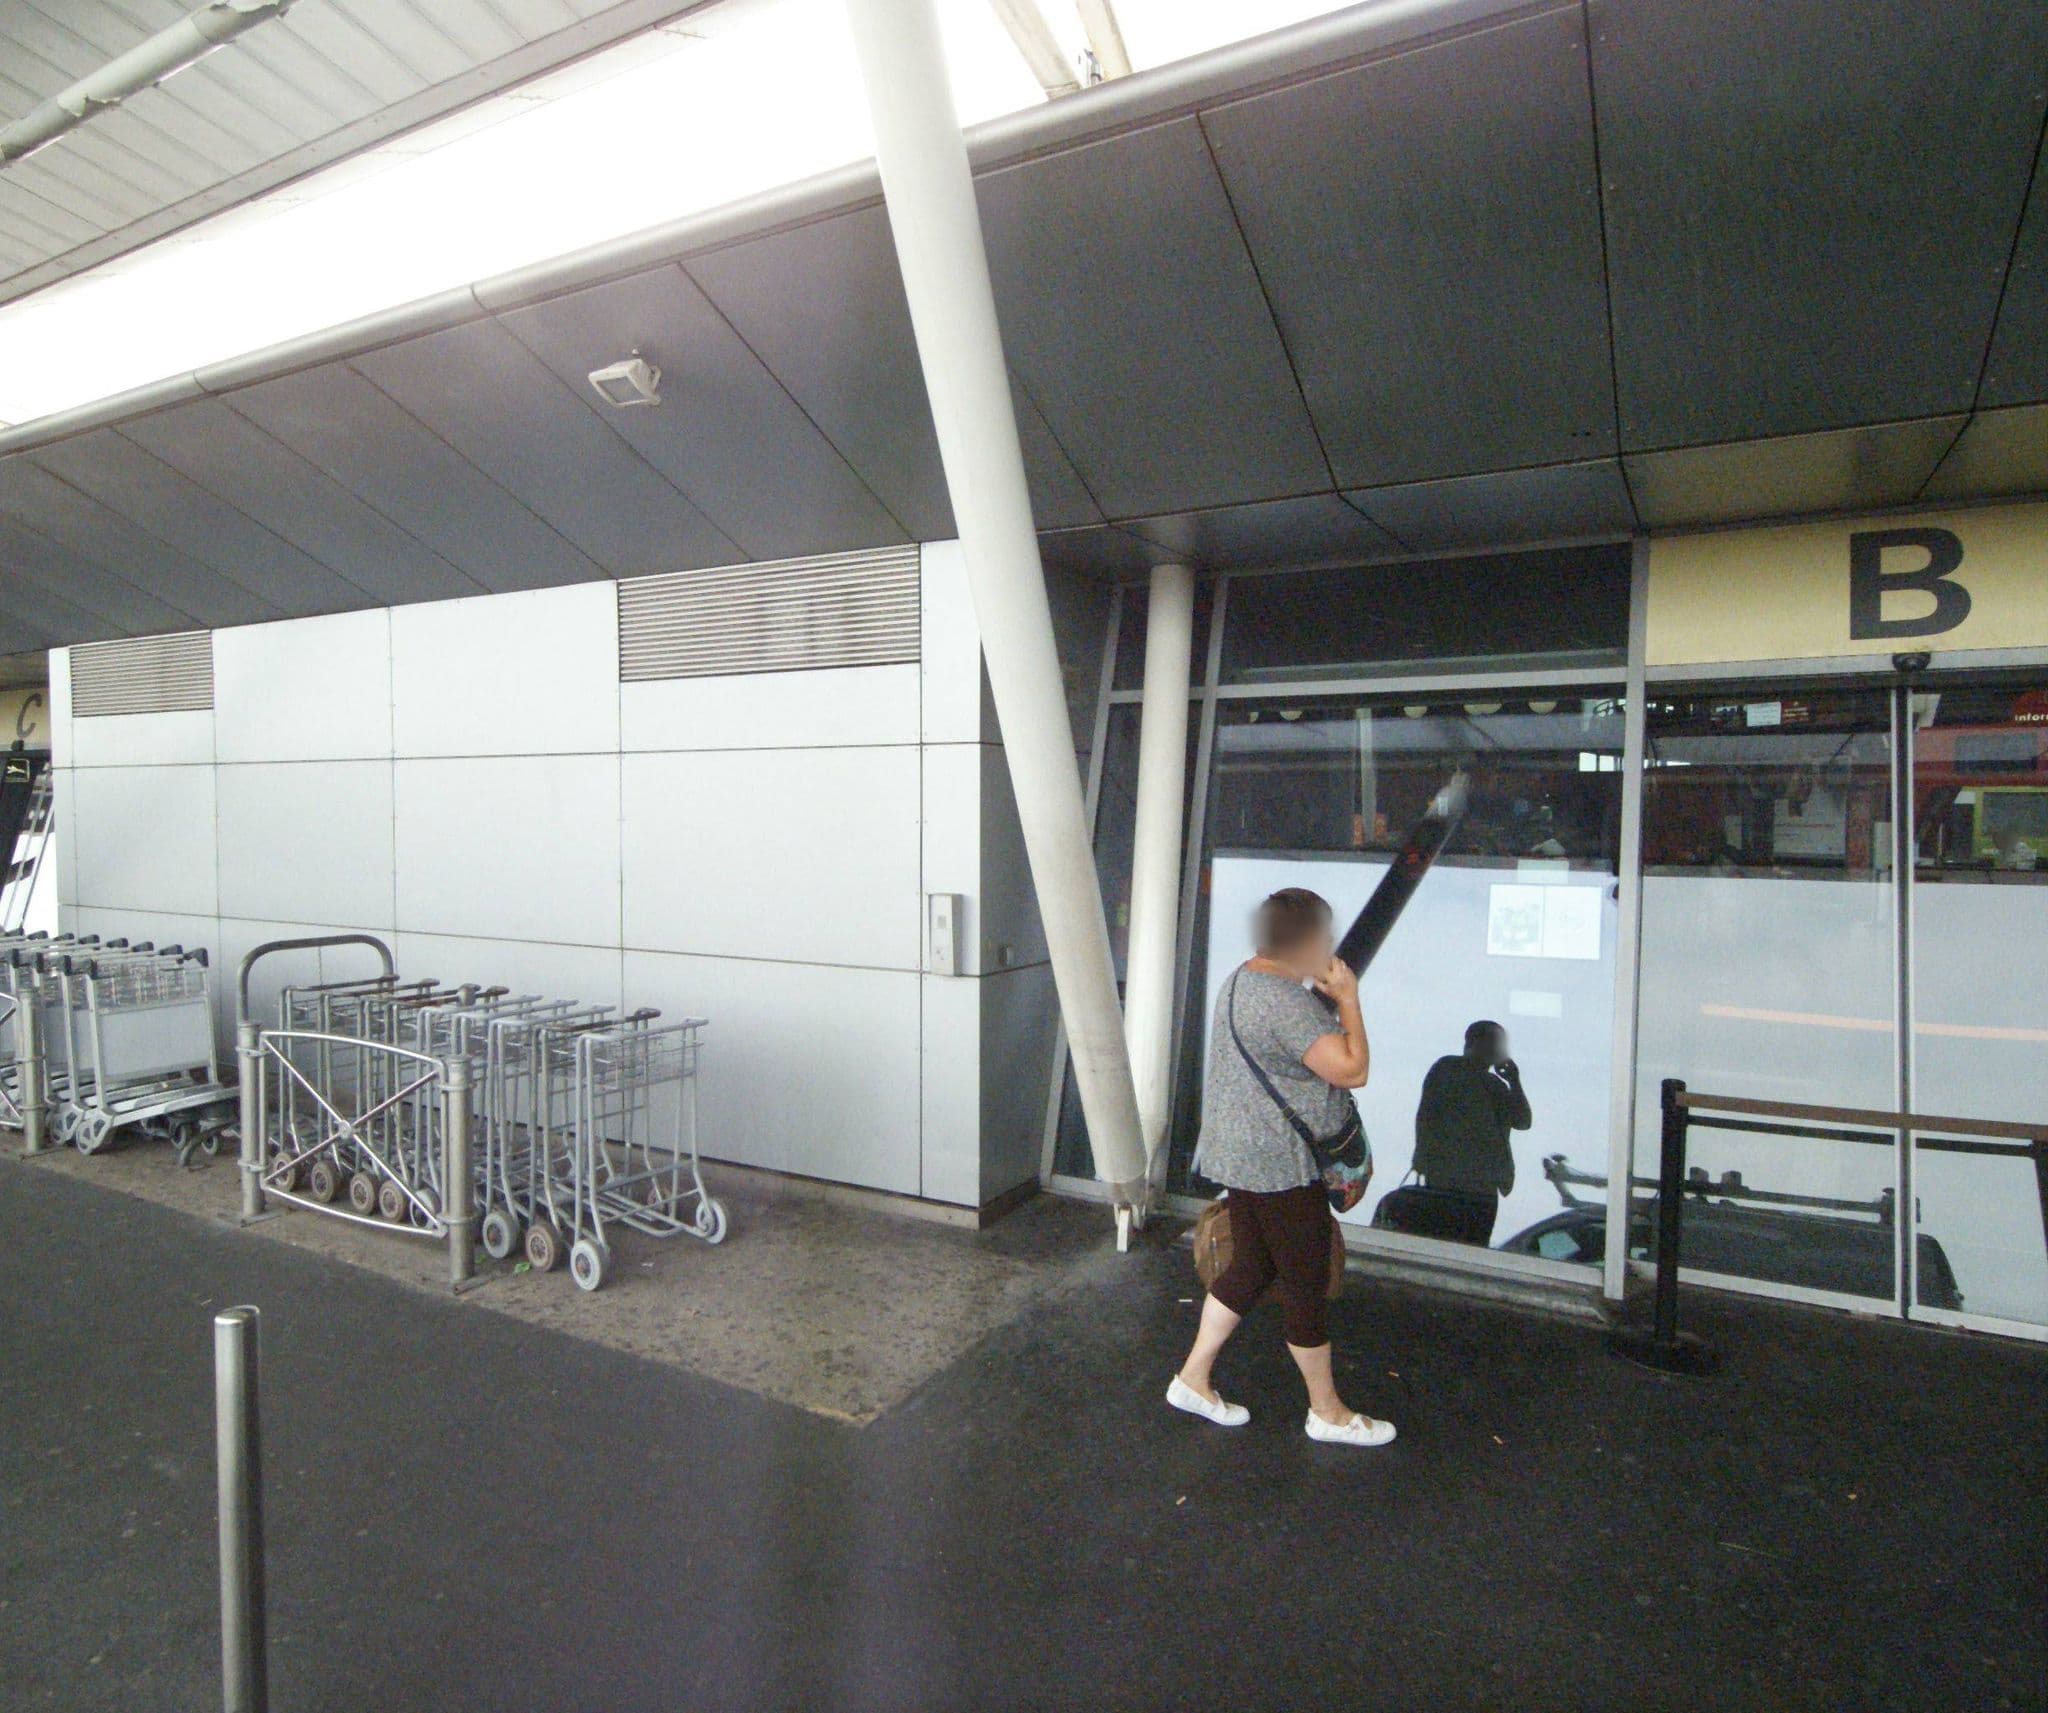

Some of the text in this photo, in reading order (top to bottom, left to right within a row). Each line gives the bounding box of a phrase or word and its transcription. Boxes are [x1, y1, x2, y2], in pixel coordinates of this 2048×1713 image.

[1850, 527, 1972, 641] B
[16, 692, 42, 738] C
[2014, 712, 2048, 722] infor
